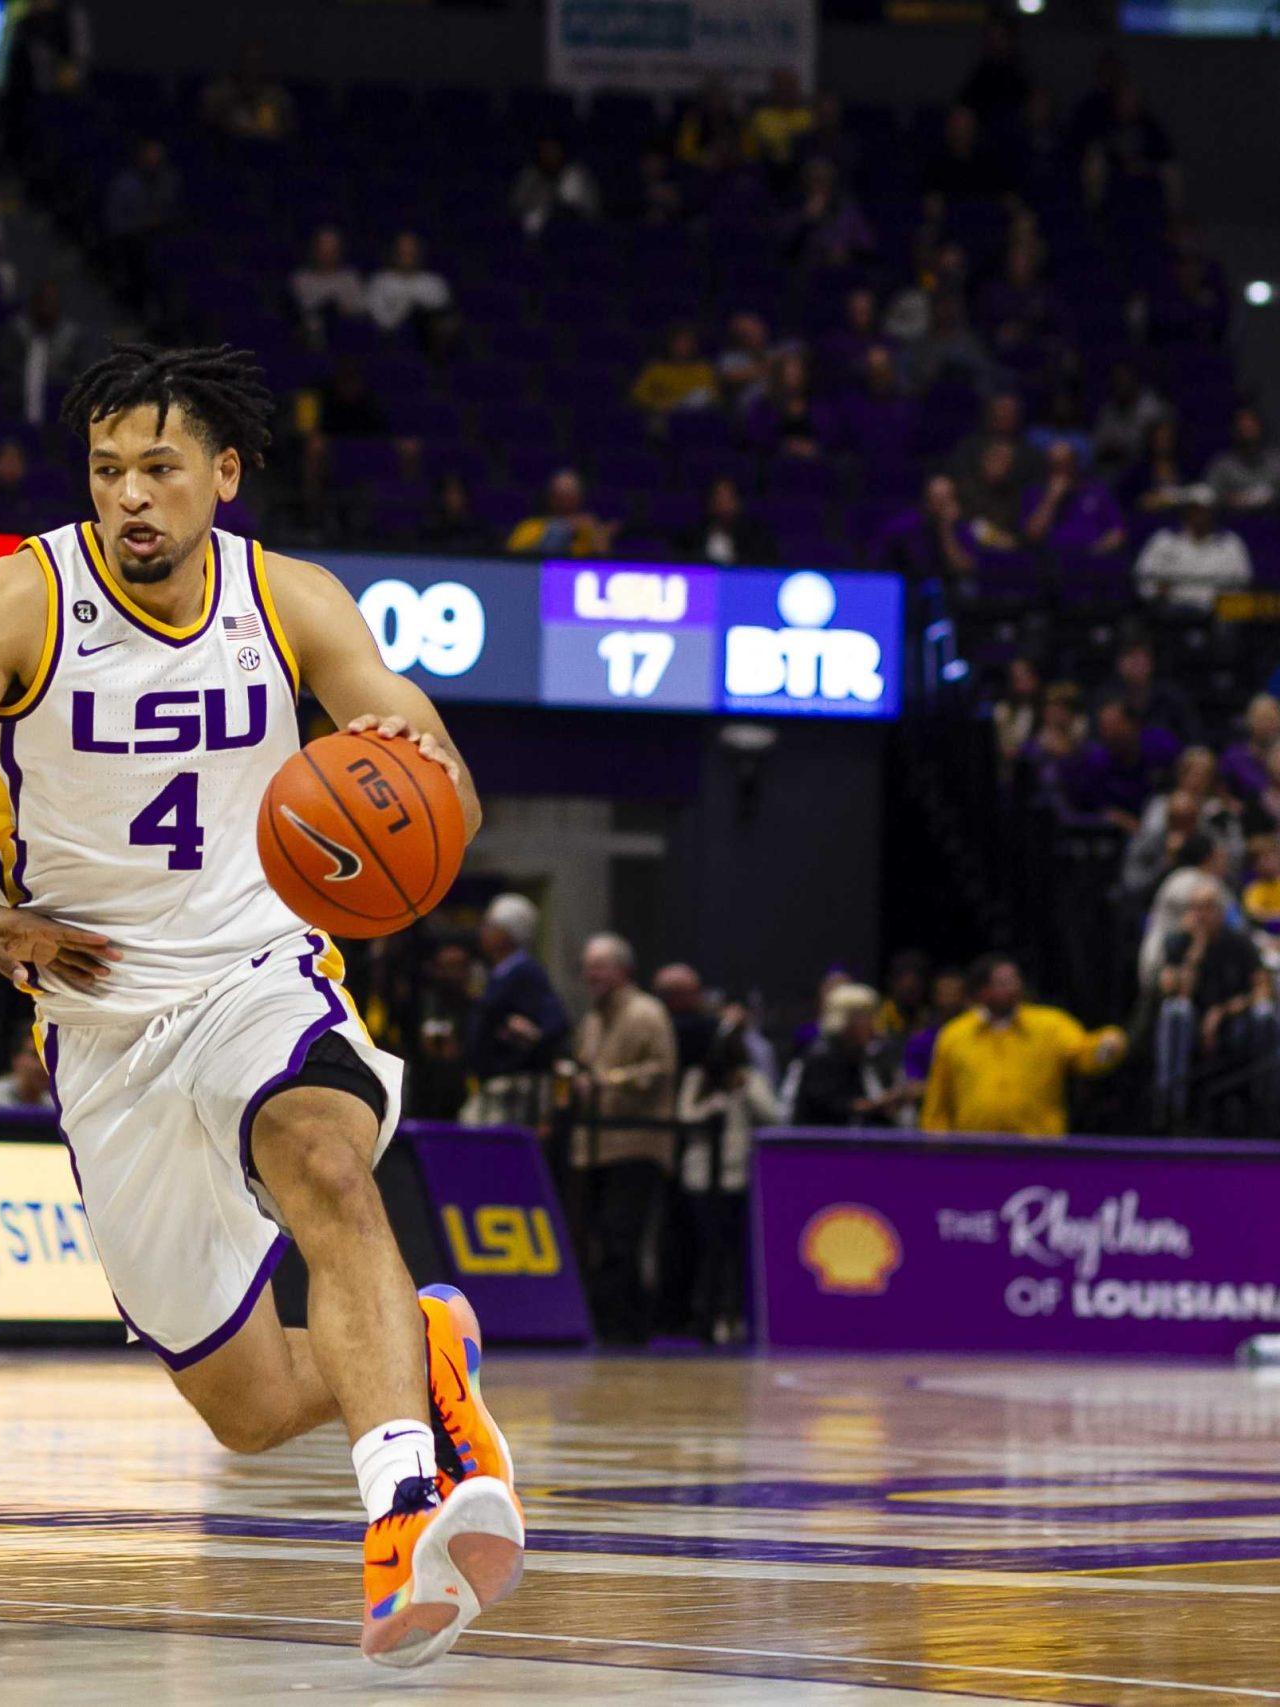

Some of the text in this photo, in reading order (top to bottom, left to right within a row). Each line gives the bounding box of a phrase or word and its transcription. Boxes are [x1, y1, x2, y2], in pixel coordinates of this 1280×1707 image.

[356, 579, 485, 677] 09
[574, 571, 688, 621] LSU
[597, 631, 675, 698] 17
[725, 626, 883, 701] BTR
[72, 684, 267, 754] LSU
[129, 772, 204, 870] 4
[346, 757, 412, 834] LSU
[441, 1205, 560, 1275] LSU
[1000, 1186, 1192, 1279] Rhythm
[1004, 1276, 1062, 1316] OF
